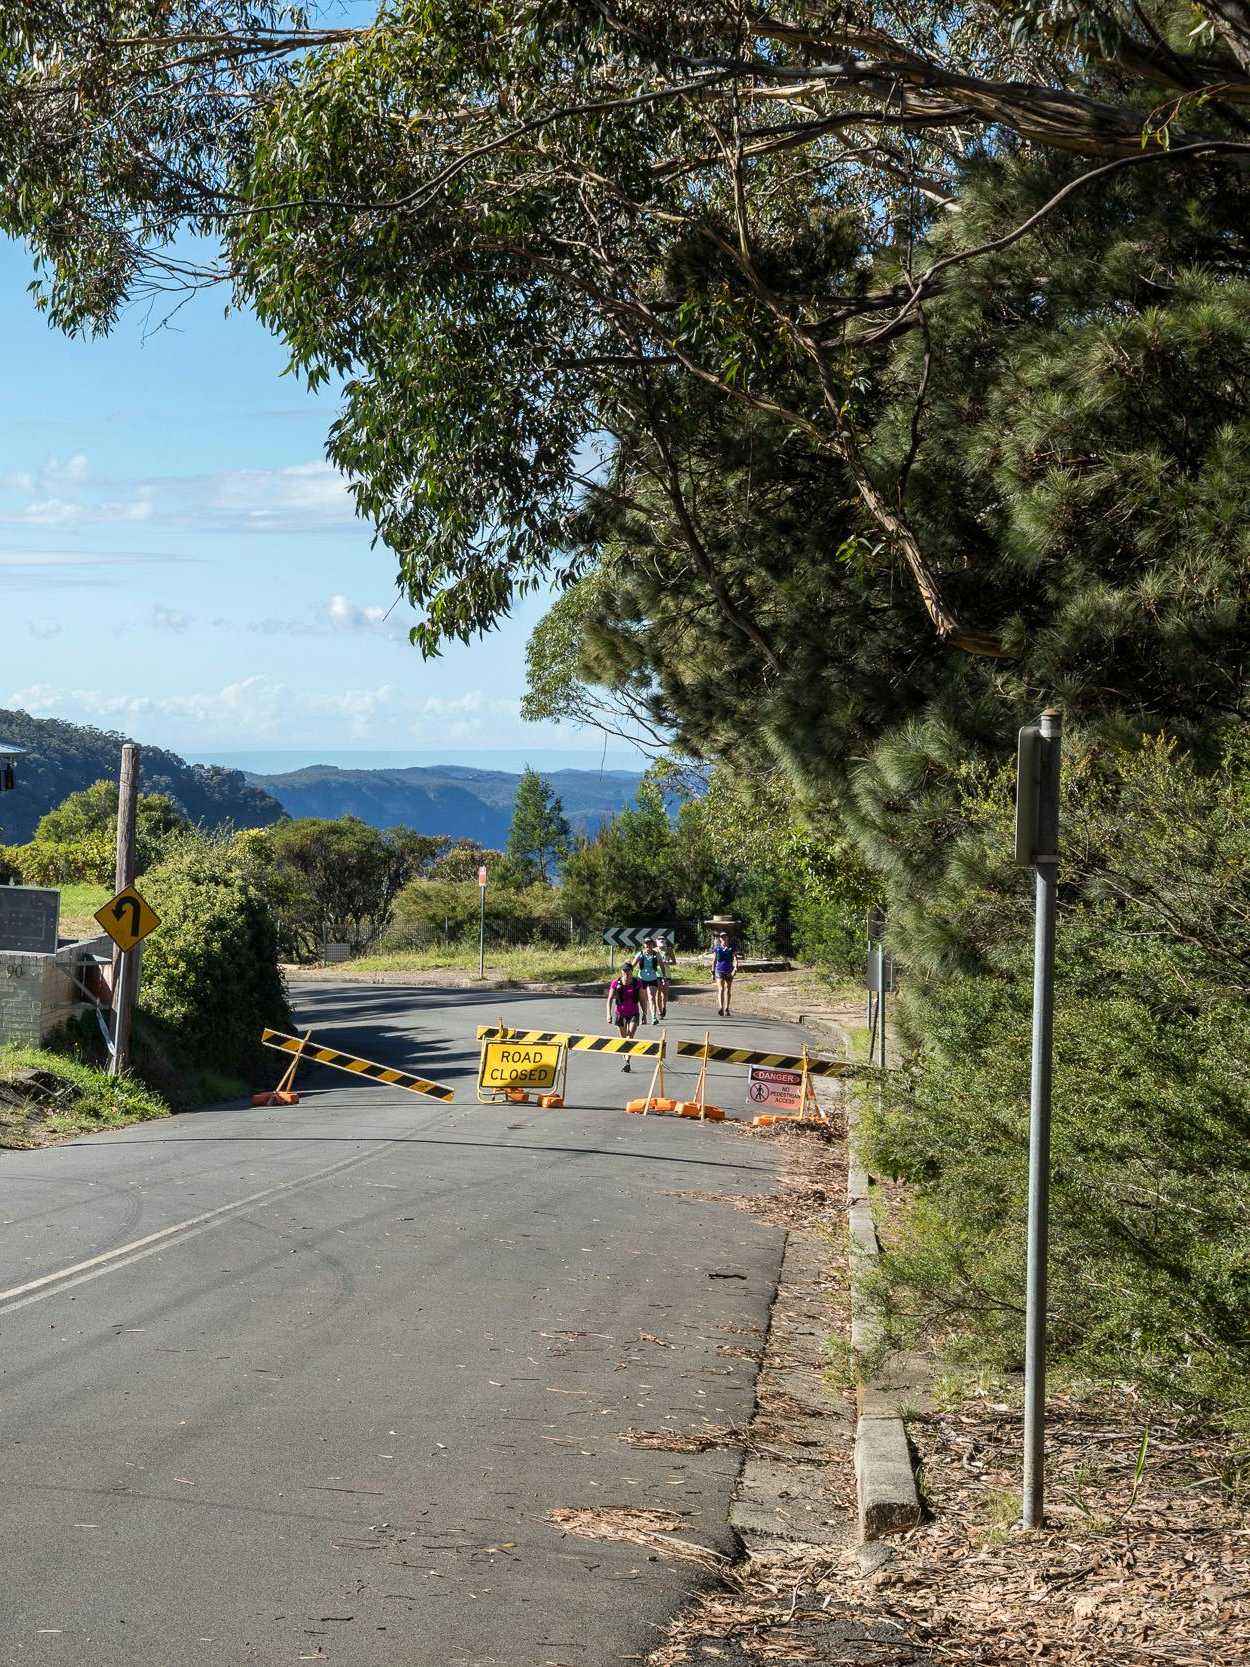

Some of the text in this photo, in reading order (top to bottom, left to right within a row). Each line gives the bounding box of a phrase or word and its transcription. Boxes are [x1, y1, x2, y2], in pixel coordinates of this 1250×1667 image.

[6, 965, 23, 979] 90
[501, 1051, 543, 1063] ROAD
[491, 1069, 548, 1081] CLOSED
[758, 1072, 794, 1082] DANGER
[770, 1091, 800, 1099] PEDESTRIAN
